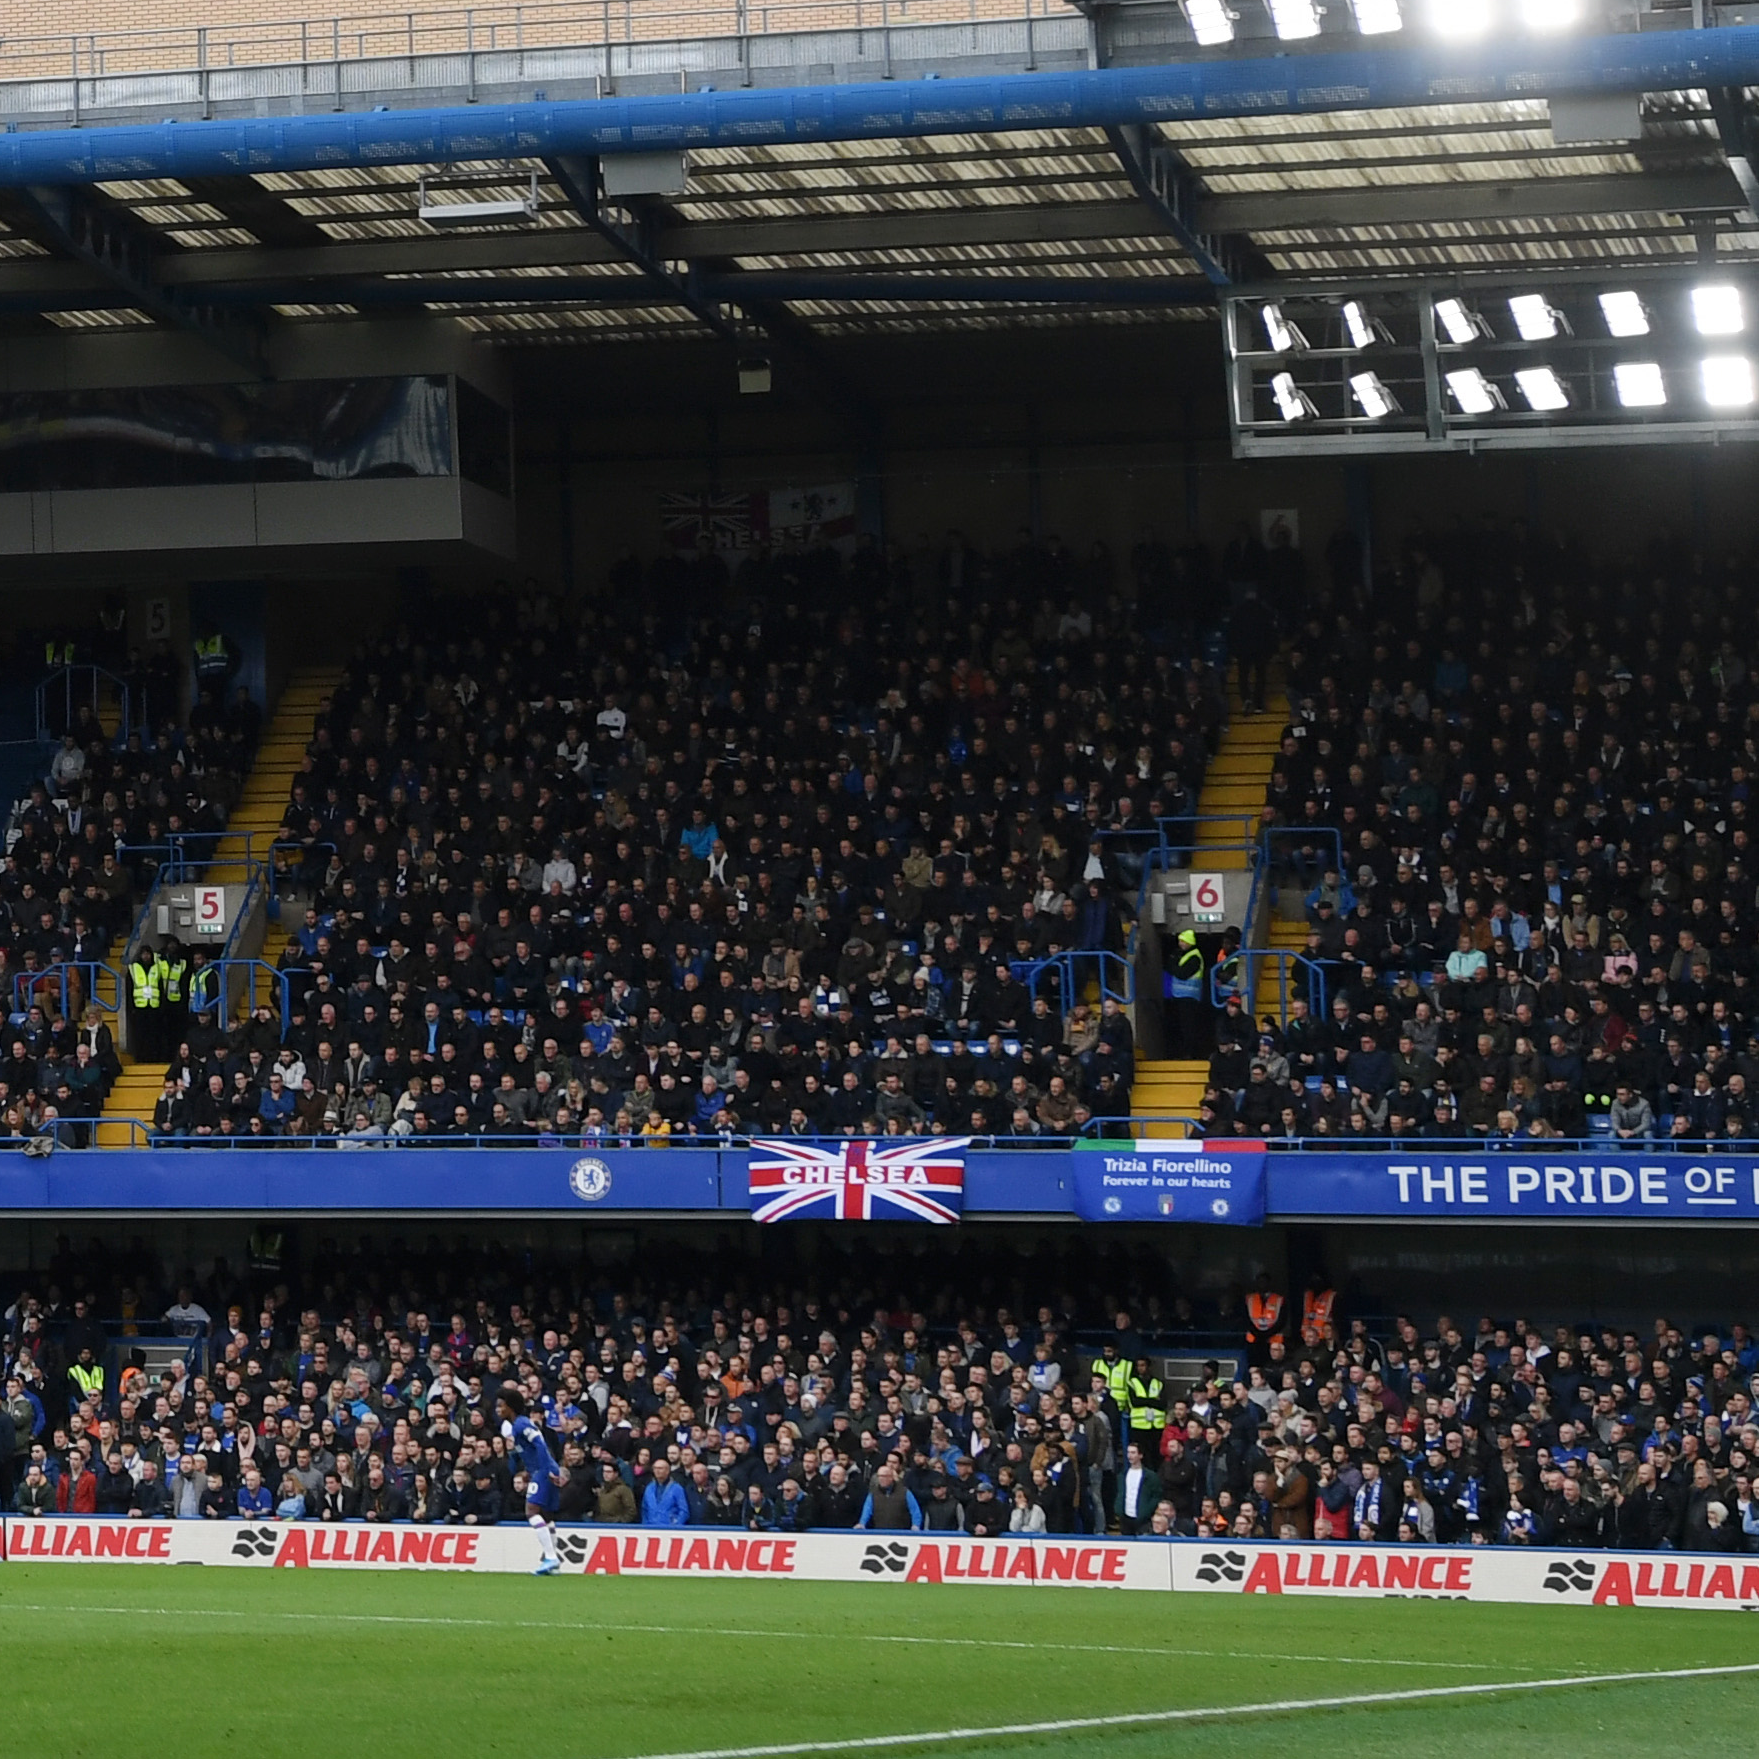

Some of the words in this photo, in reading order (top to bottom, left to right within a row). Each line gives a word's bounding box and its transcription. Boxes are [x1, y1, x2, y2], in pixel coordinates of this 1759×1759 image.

[151, 604, 164, 634] 5
[201, 892, 219, 919] 5
[1196, 879, 1219, 908] 6
[782, 1165, 928, 1185] CHELSEA
[1103, 1157, 1147, 1172] Trizia
[1152, 1158, 1232, 1174] Fiorellino
[1103, 1175, 1149, 1187] Forever
[1152, 1175, 1164, 1187] in
[1167, 1177, 1188, 1187] our
[1192, 1176, 1231, 1189] hearts
[1388, 1166, 1489, 1204] THE
[1508, 1166, 1669, 1205] PRIDE
[1684, 1166, 1736, 1194] OF
[274, 1529, 479, 1568] ALLIANCE
[583, 1536, 797, 1575] ALLIANCE
[905, 1544, 1127, 1583] ALLIANCE
[1242, 1552, 1474, 1594] ALLIANCE
